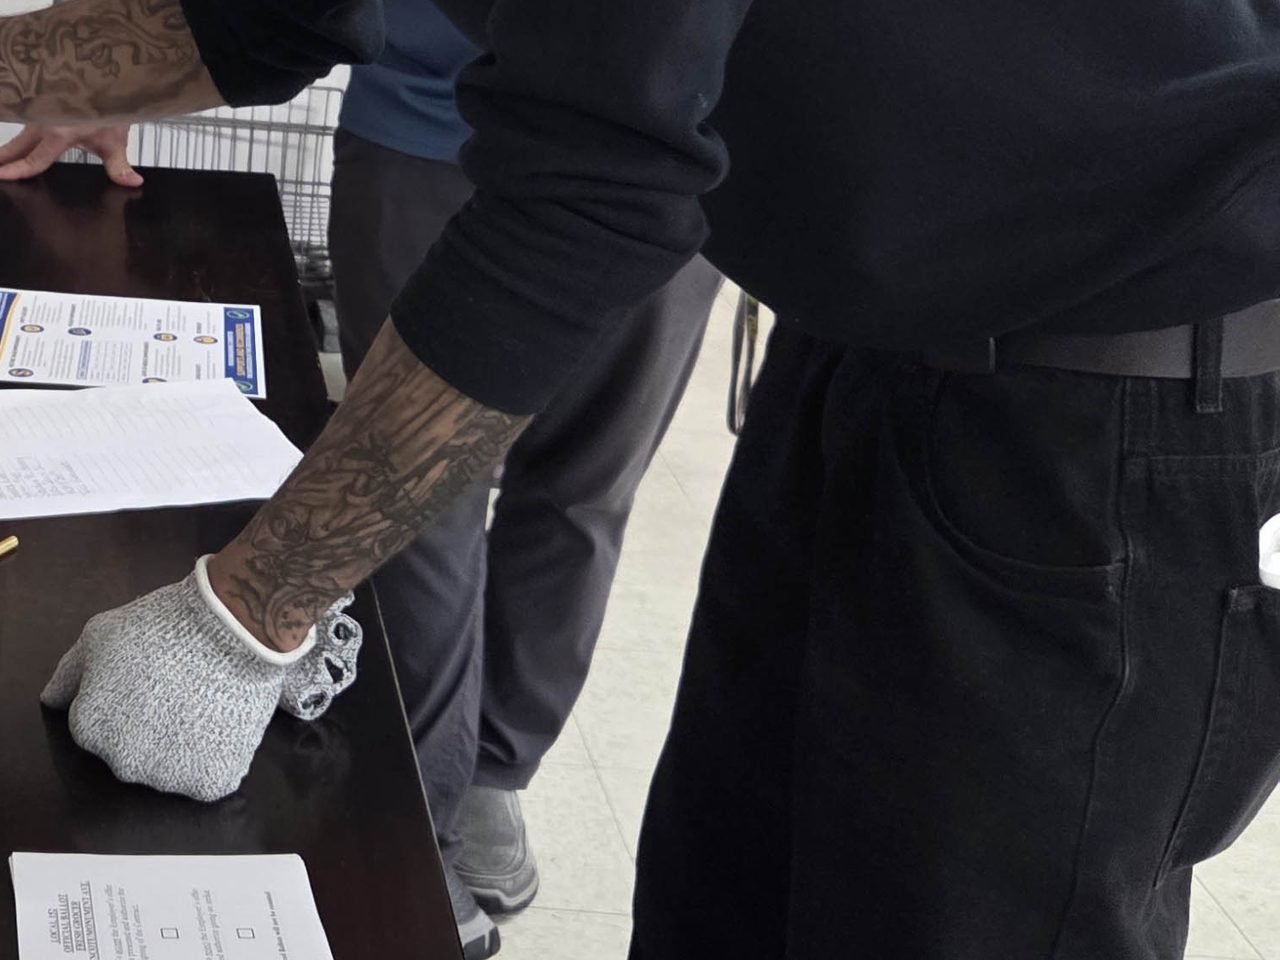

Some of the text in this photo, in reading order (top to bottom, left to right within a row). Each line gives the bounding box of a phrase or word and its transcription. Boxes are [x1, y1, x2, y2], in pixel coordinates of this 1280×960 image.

[48, 920, 60, 944] LOCAL
[57, 893, 74, 954] OFFICIAL BALLOT
[71, 901, 87, 952] FRESH GROCER
